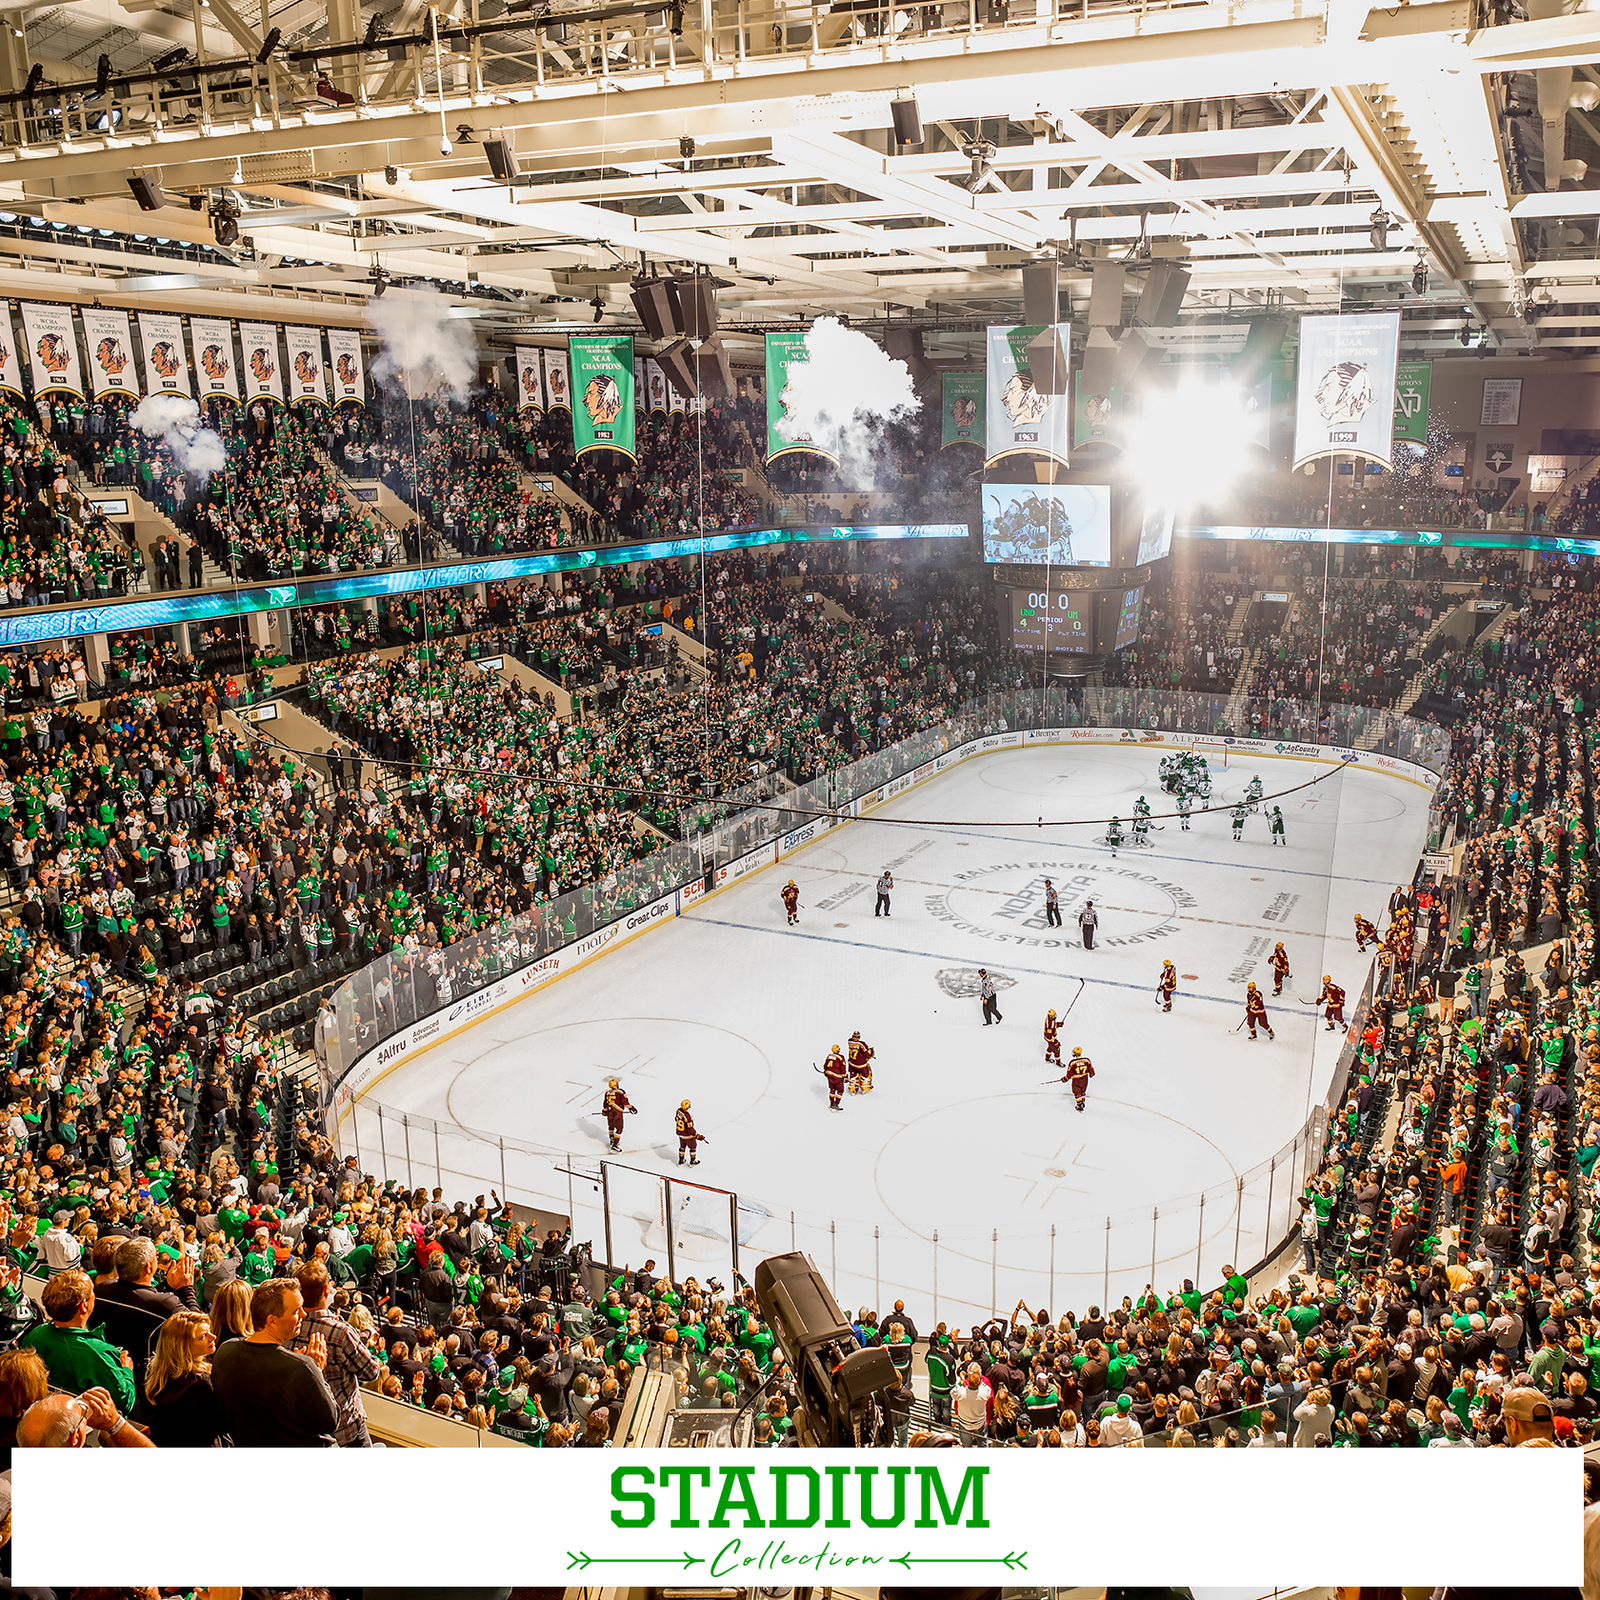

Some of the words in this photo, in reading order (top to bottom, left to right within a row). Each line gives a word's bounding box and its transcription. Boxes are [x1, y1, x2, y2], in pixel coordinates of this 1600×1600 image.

[1334, 338, 1362, 346] NCAA
[1318, 347, 1379, 357] CHAMPIONS
[581, 363, 622, 371] CHAMPIONS
[1018, 433, 1034, 441] 1963
[906, 525, 967, 537] VICTORY
[1249, 527, 1318, 541] VICTORY
[668, 538, 714, 556] VICTORY
[420, 563, 490, 588] VICTORY
[1028, 592, 1069, 610] 00.0
[1020, 608, 1035, 617] UND
[1067, 611, 1078, 619] UM
[1037, 616, 1063, 624] PERIOD
[0, 608, 110, 641] ICTORY
[1020, 618, 1028, 627] 4
[1047, 623, 1053, 632] 3
[1073, 621, 1081, 630] 0
[1036, 730, 1060, 738] Bremer
[1286, 744, 1321, 754] AgCountry
[953, 863, 1021, 880] RALPH
[1027, 861, 1158, 882] ENGELSTAD
[1154, 882, 1198, 908] ARENA
[991, 874, 1060, 920] NORTH
[924, 894, 959, 922] ARENA
[627, 912, 650, 930] Great
[650, 902, 669, 918] Clips
[577, 926, 618, 956] marco
[1106, 924, 1181, 947] RALPH
[521, 958, 560, 985] LUNSETH
[467, 990, 491, 1008] EIDE
[412, 1019, 440, 1038] Advanced
[383, 1040, 407, 1063] Altru
[1075, 1065, 1088, 1074] 17
[500, 1426, 526, 1440] GENERAL
